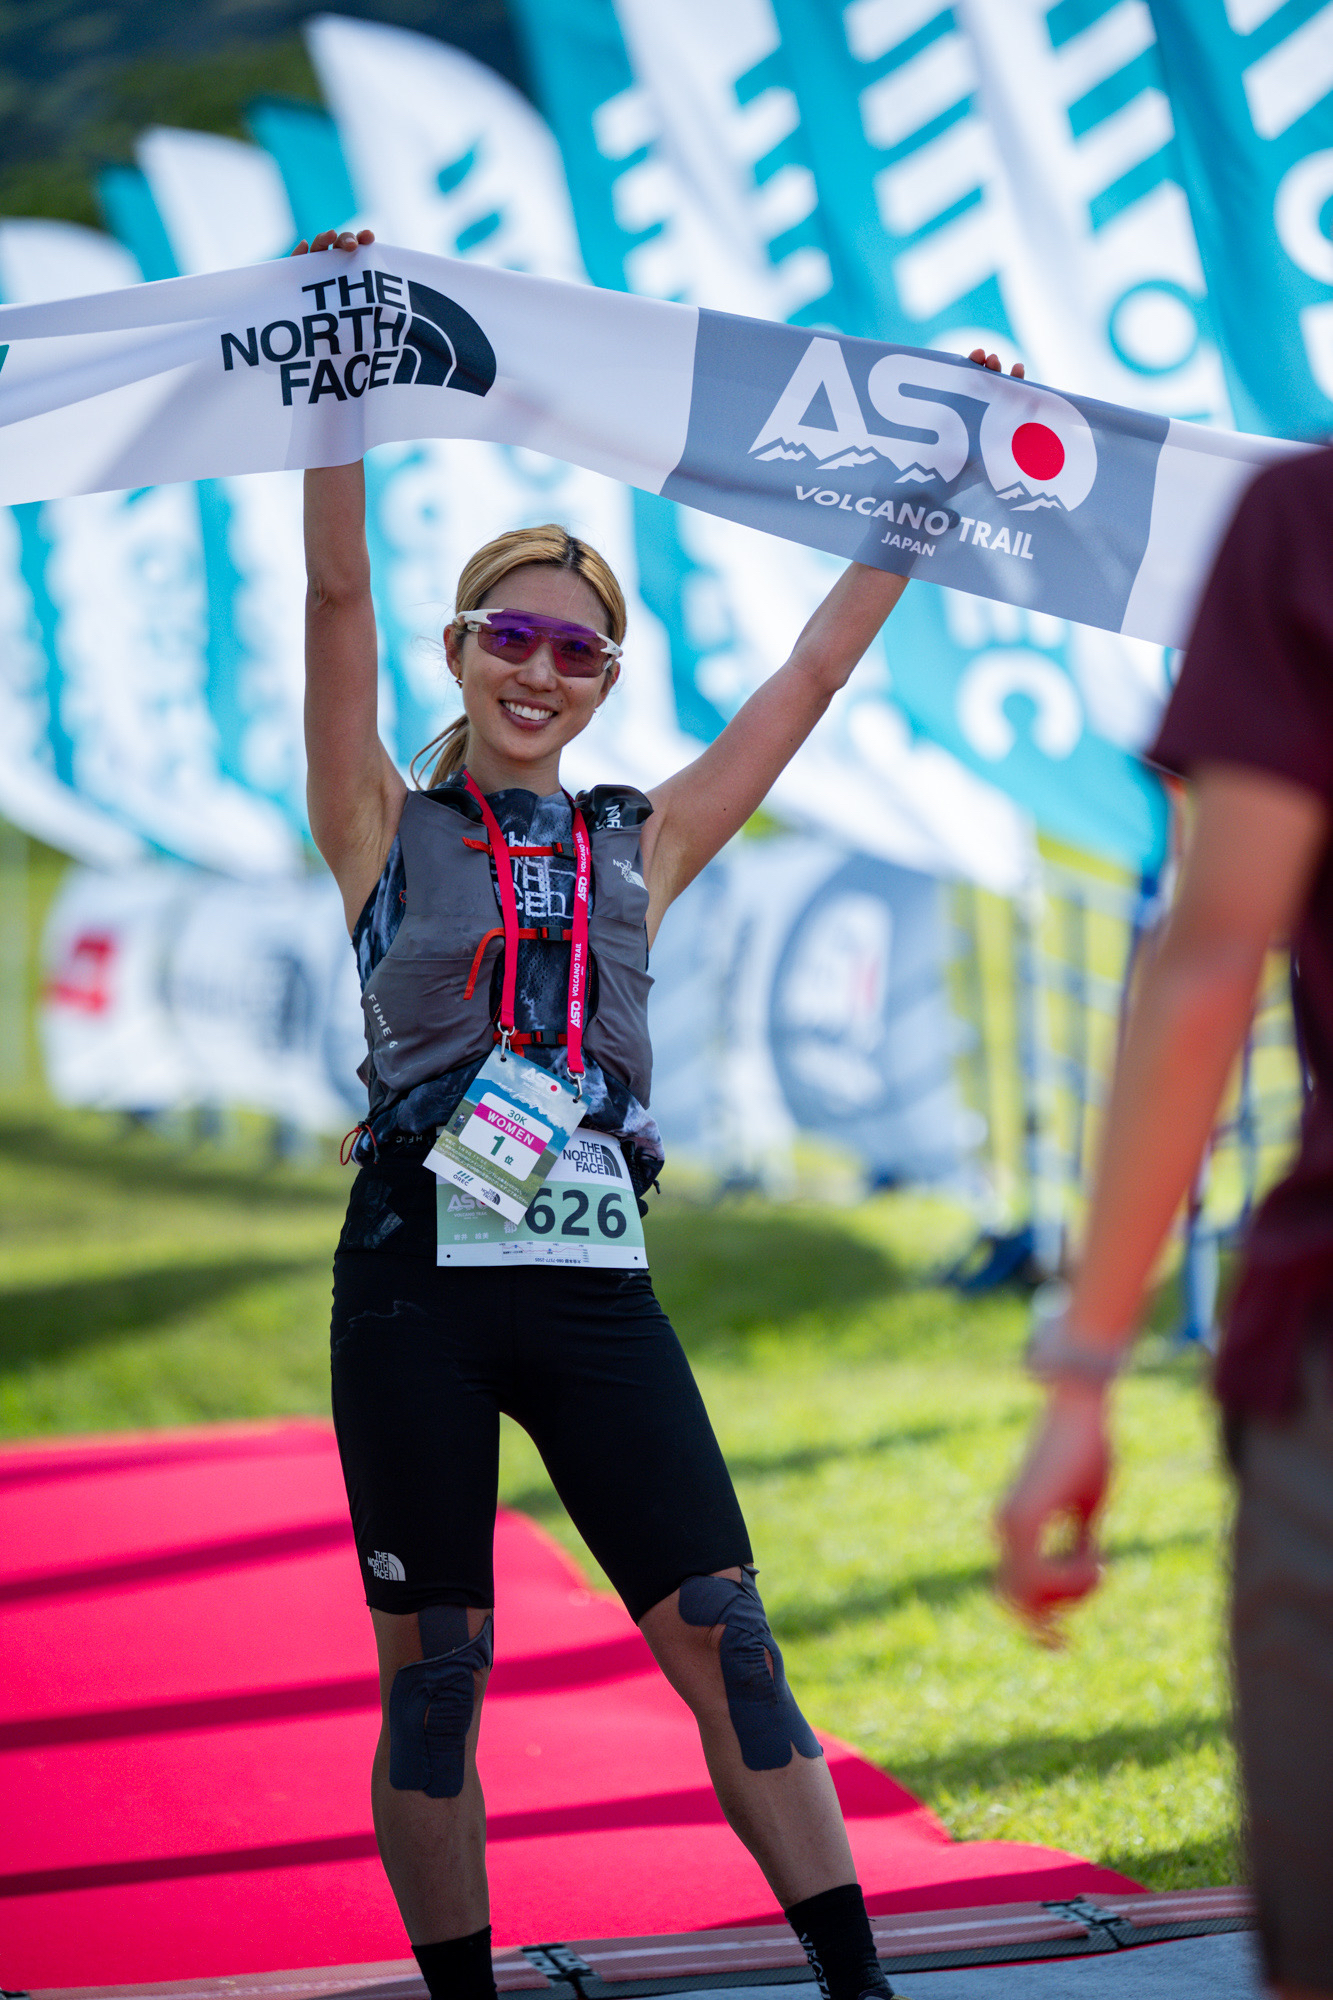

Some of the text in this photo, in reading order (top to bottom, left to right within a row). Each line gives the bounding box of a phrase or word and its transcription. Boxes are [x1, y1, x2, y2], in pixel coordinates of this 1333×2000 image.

[302, 269, 407, 312] THE
[220, 306, 409, 371] NORTH
[280, 348, 399, 407] FACE
[747, 336, 1098, 512] ASO
[794, 485, 1035, 561] VOLCANO TRAIL
[880, 531, 937, 558] JAPAN
[578, 844, 587, 873] VOLCANO
[577, 876, 588, 902] ASO
[574, 942, 582, 962] TRAIL
[572, 962, 581, 997] VOLCANO
[368, 993, 399, 1049] FUME 6
[570, 1000, 582, 1029] ASO
[487, 1110, 535, 1146] WOMEN
[507, 1109, 528, 1126] 30K
[490, 1135, 506, 1156] 1
[562, 1149, 603, 1164] NORTH
[579, 1140, 601, 1154] THE
[576, 1161, 604, 1175] FACE
[367, 1556, 389, 1571] NORTH
[374, 1550, 388, 1562] THE
[373, 1567, 389, 1580] FACE
